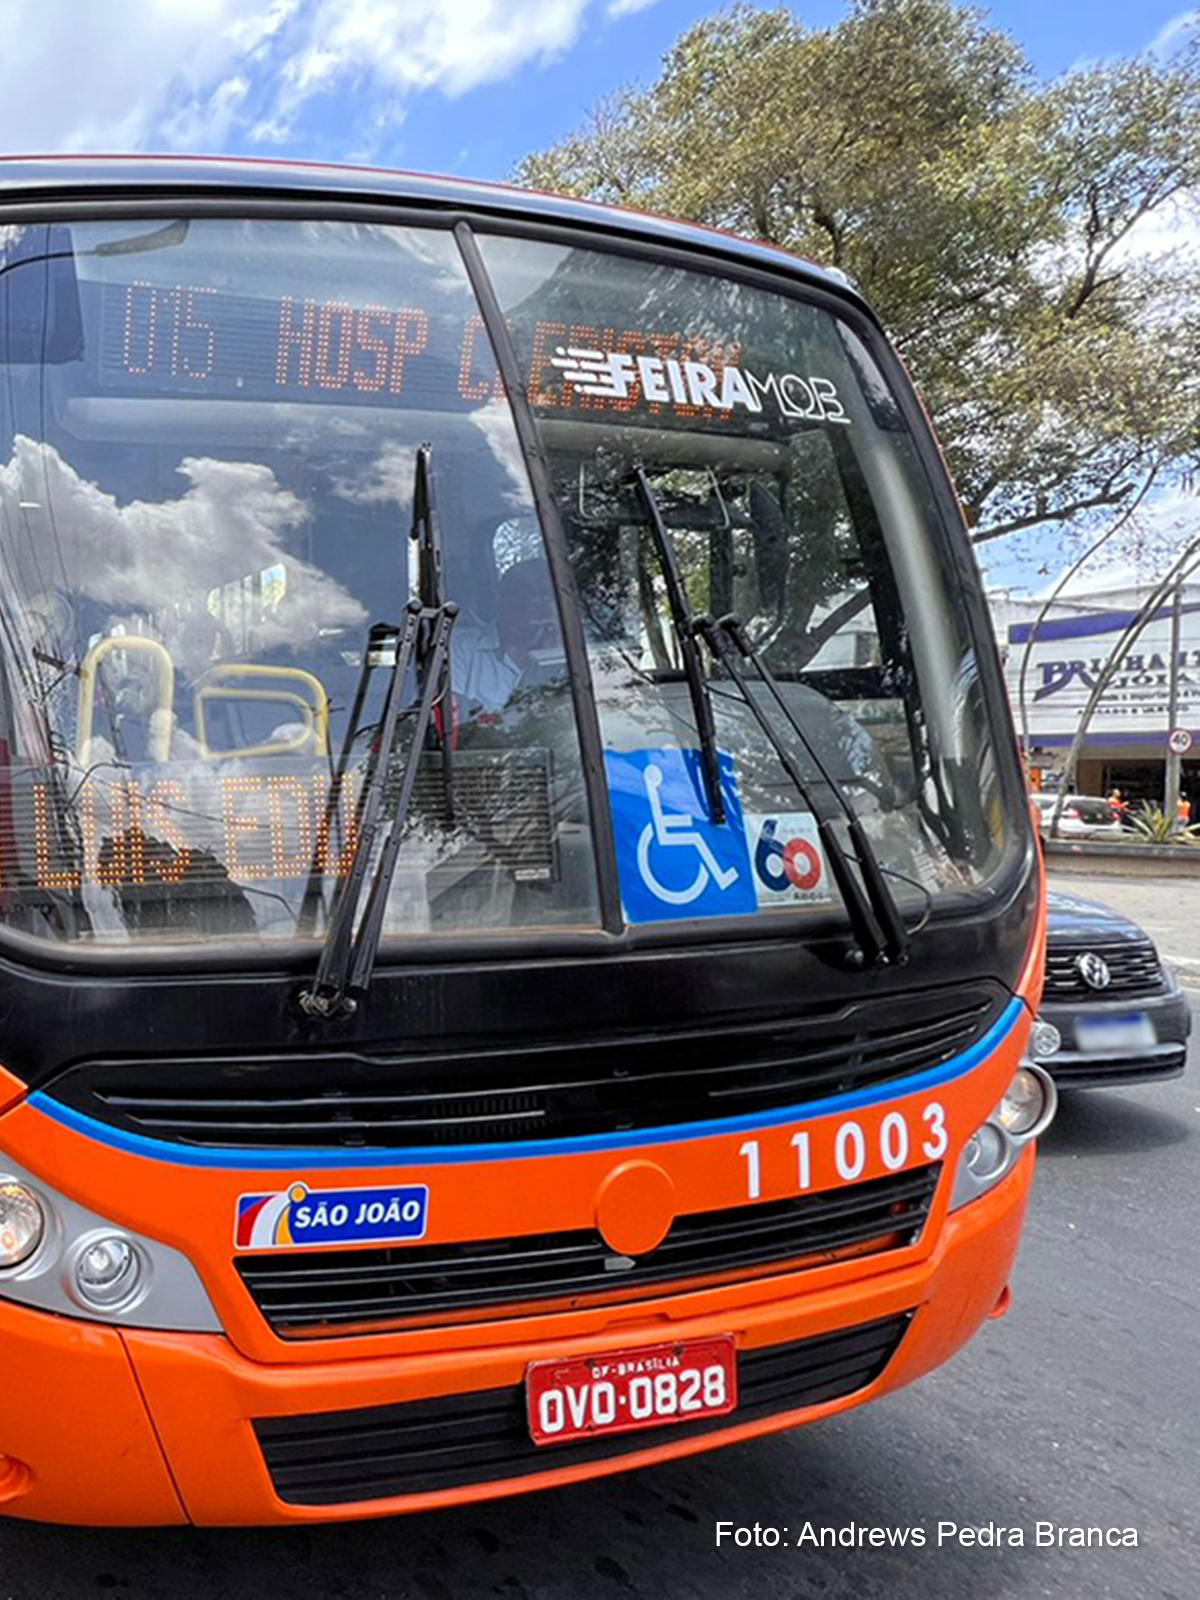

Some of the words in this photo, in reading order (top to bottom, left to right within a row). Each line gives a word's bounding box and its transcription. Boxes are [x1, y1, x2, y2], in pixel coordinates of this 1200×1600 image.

[123, 280, 218, 379] 015
[275, 295, 429, 394] HOSP
[32, 779, 191, 888] LUIS
[755, 819, 822, 892] 60
[738, 1101, 949, 1199] 11003
[294, 1201, 349, 1229] SÃO
[354, 1197, 421, 1225] JOÃO
